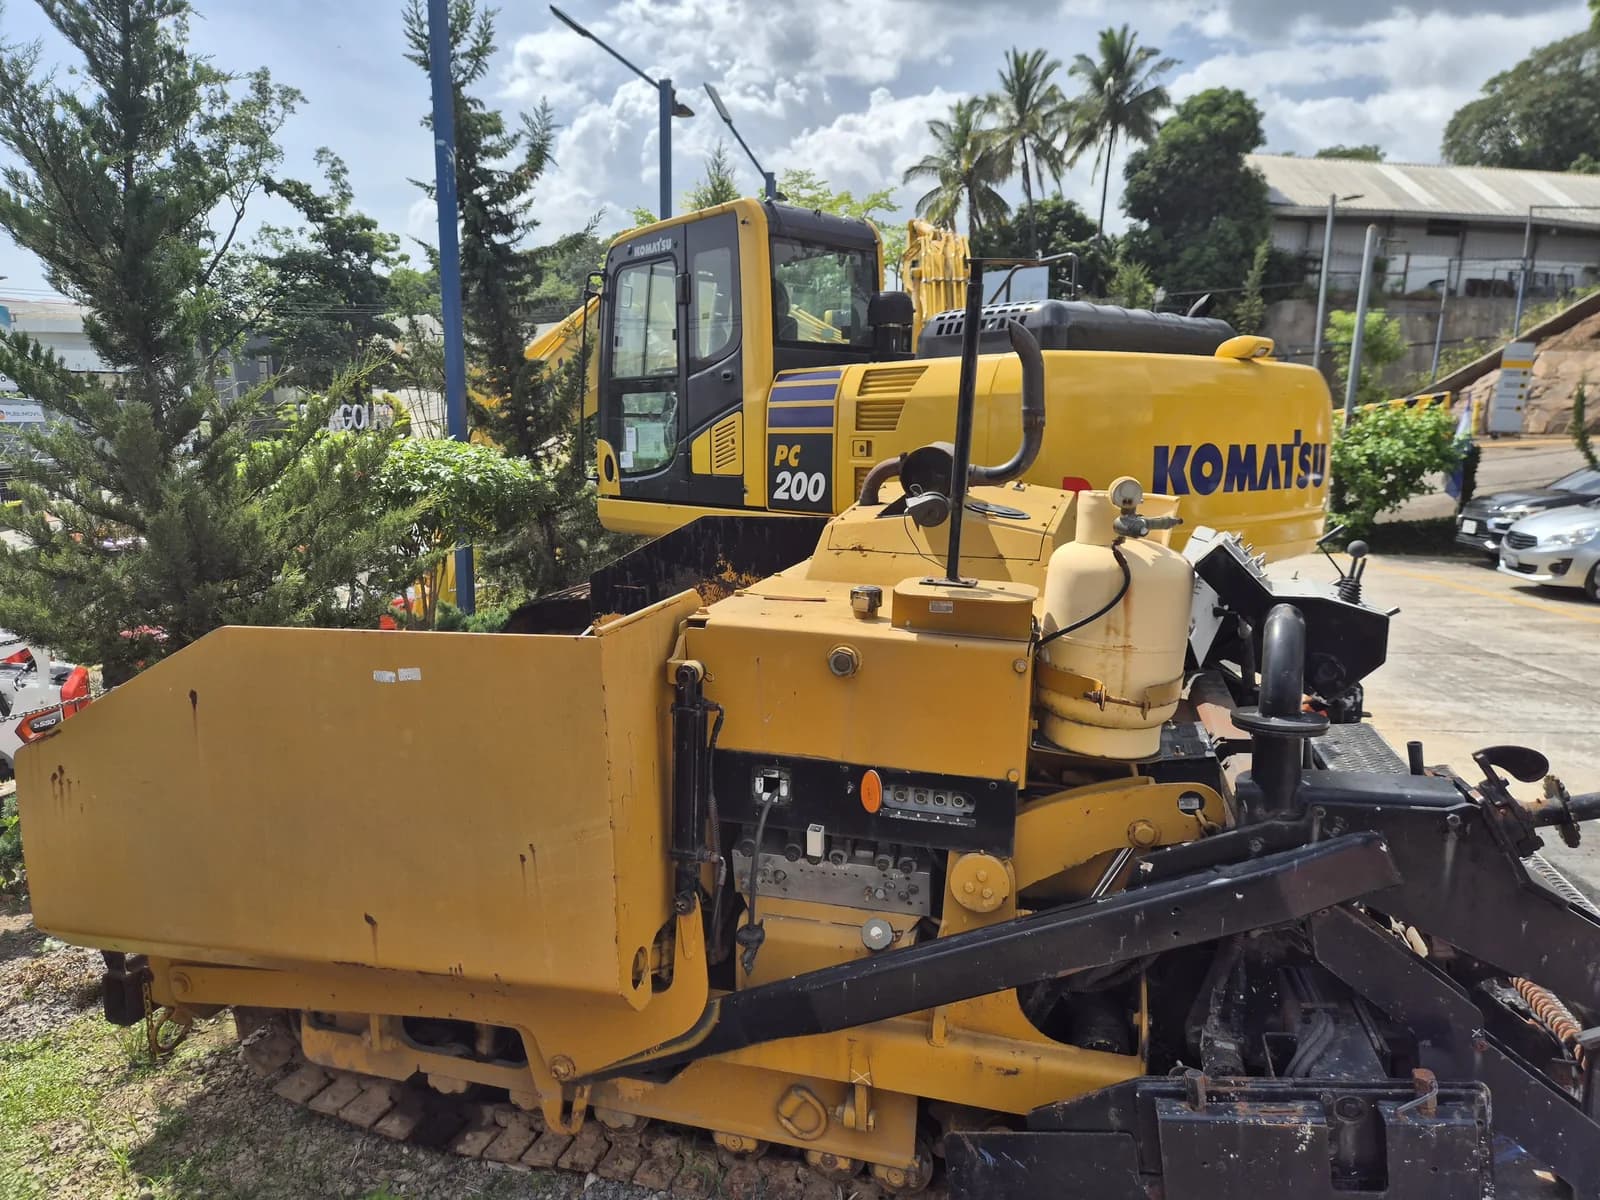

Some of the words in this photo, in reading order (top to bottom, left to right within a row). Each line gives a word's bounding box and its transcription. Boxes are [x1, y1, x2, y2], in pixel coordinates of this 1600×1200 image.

[634, 237, 672, 256] KOMATSU
[774, 444, 801, 467] PC
[1152, 429, 1326, 496] KOMATSU
[773, 470, 826, 502] 200
